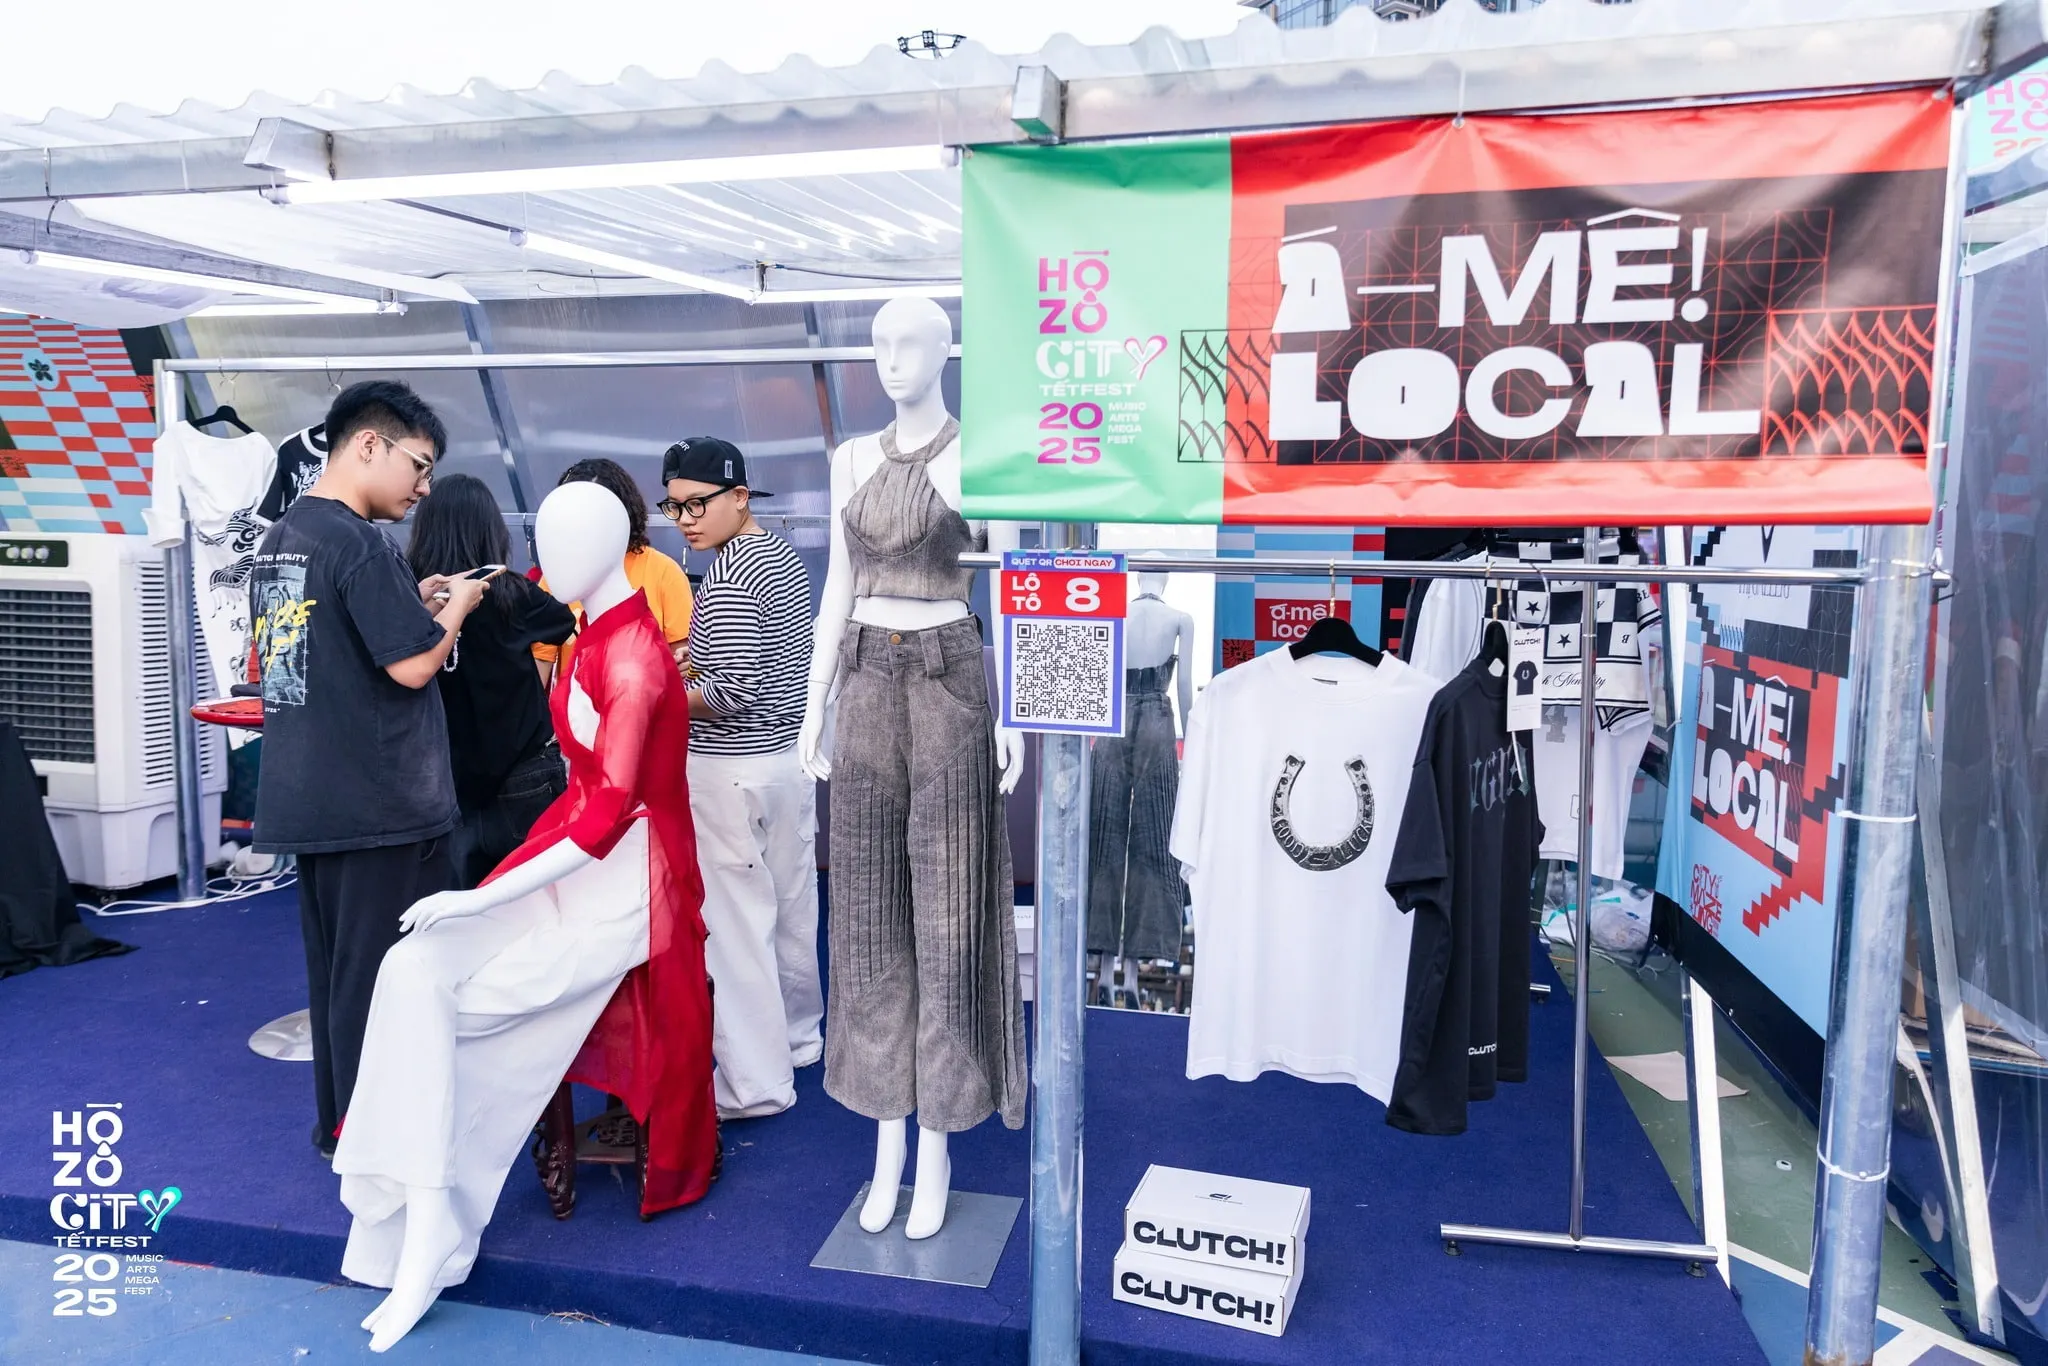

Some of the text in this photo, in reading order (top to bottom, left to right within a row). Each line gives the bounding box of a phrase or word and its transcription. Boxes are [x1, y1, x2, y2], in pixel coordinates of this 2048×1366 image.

[1269, 340, 1761, 441] LOCAL
[1038, 402, 1104, 430] 20
[1108, 402, 1147, 411] MUSIC
[1109, 412, 1140, 422] ARTS
[1106, 434, 1136, 444] FEST
[1108, 423, 1142, 433] MEGA
[1037, 436, 1102, 464] 25
[1038, 558, 1053, 567] QR
[1084, 559, 1113, 567] NGAY
[1012, 572, 1041, 592] LÔ
[1011, 592, 1042, 611] TÔ
[1065, 577, 1100, 612] 8
[1692, 737, 1799, 863] LOCAL
[1133, 1220, 1287, 1266] CLUTCH!
[1120, 1271, 1275, 1326] CLUTCH!
